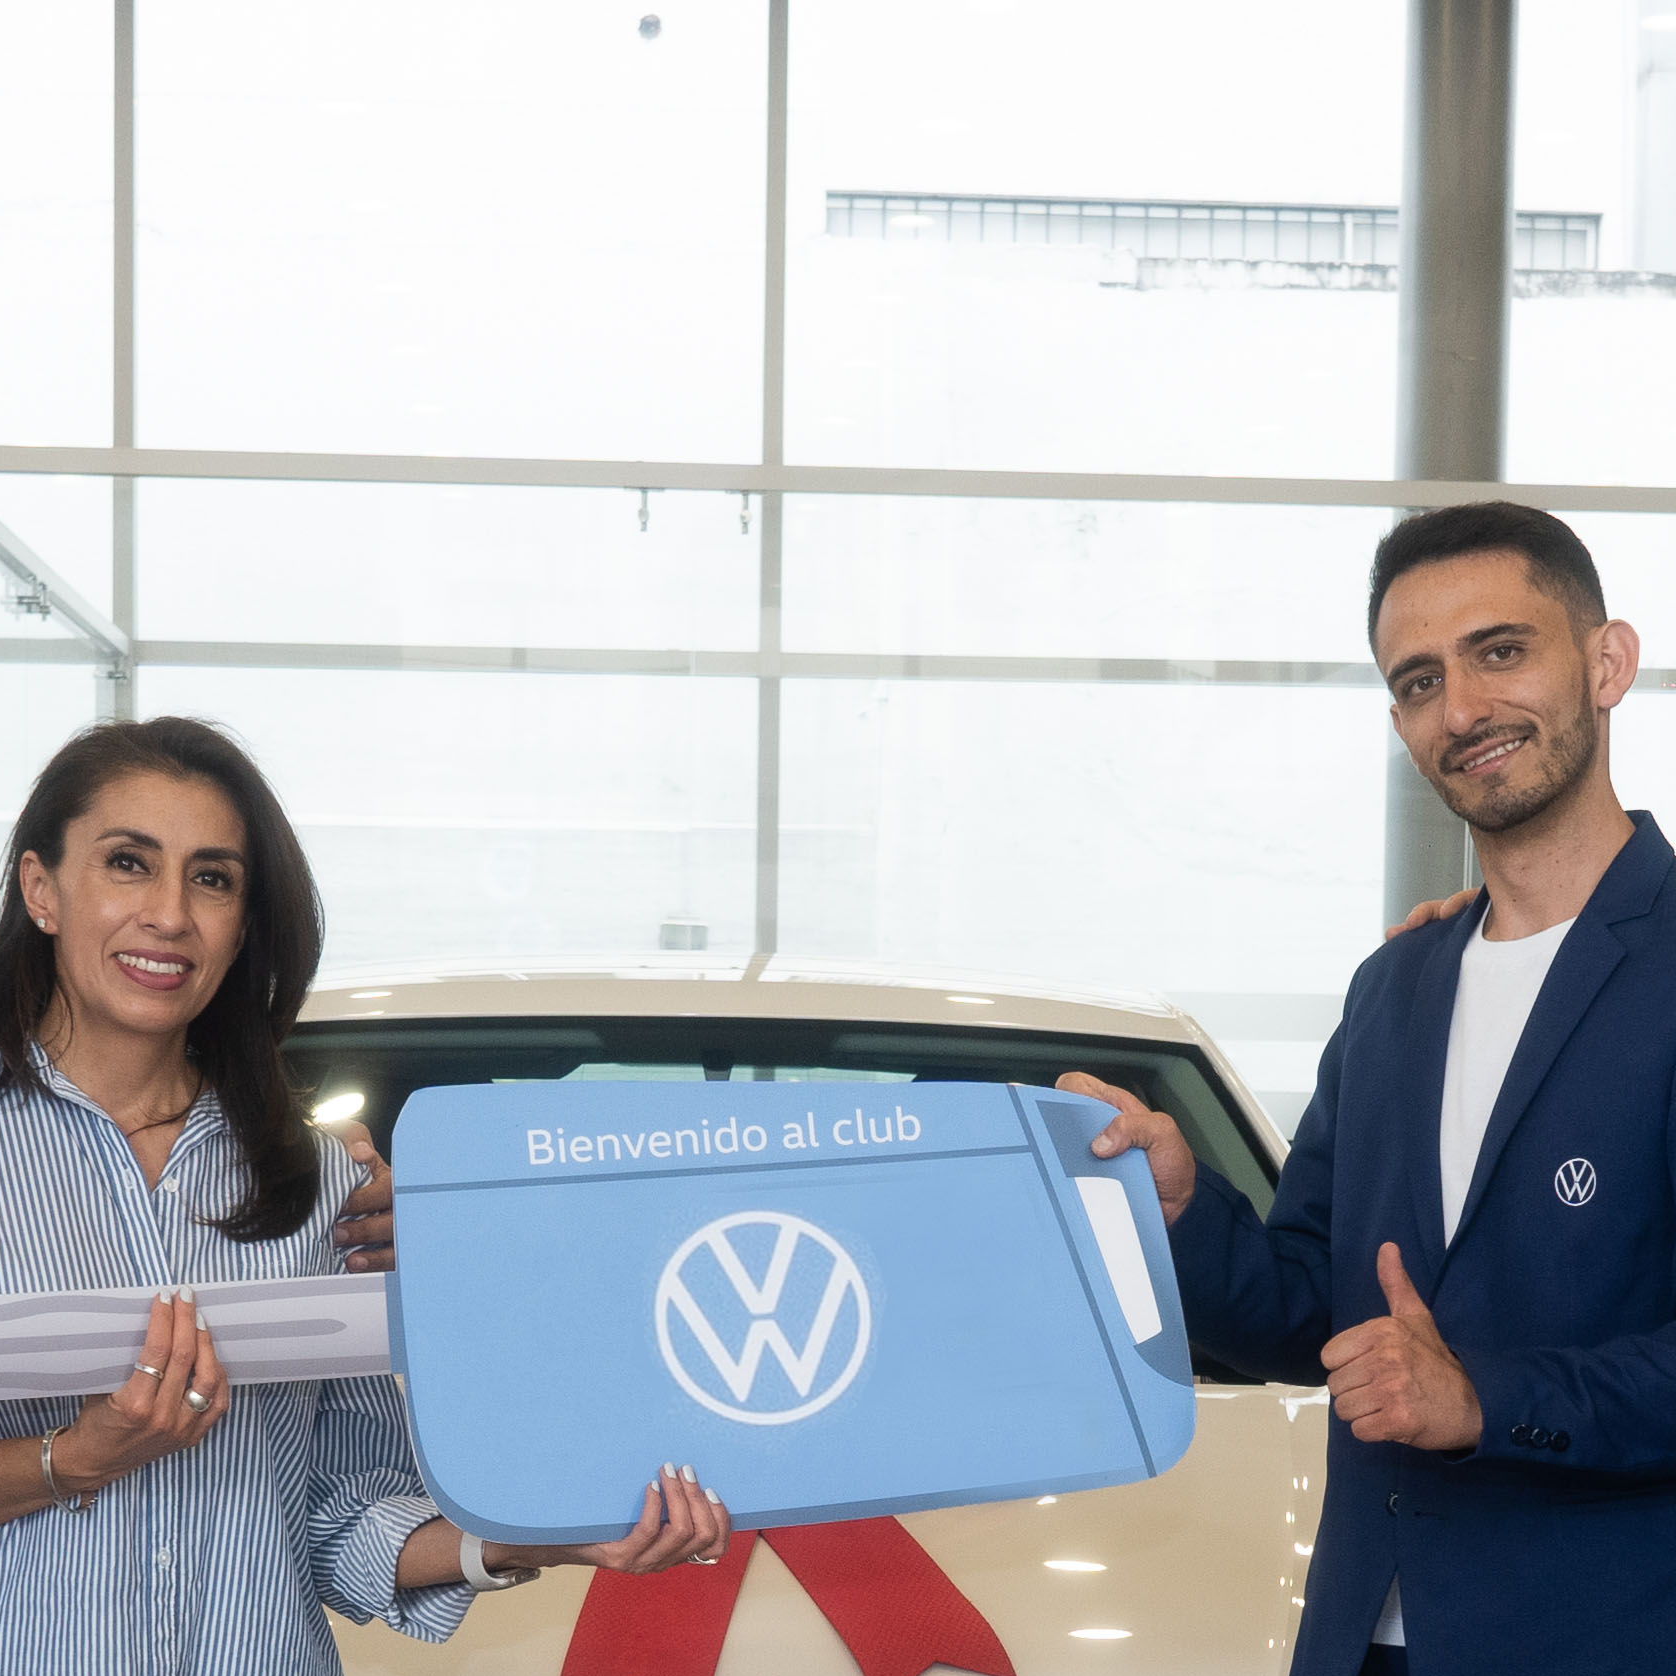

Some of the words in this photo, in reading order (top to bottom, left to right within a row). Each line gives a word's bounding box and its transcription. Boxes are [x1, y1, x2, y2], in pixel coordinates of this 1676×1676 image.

[526, 1116, 769, 1167] Bienvenido
[781, 1112, 821, 1151] al
[831, 1104, 923, 1148] club
[1556, 1159, 1596, 1203] VW
[658, 1213, 869, 1408] VW
